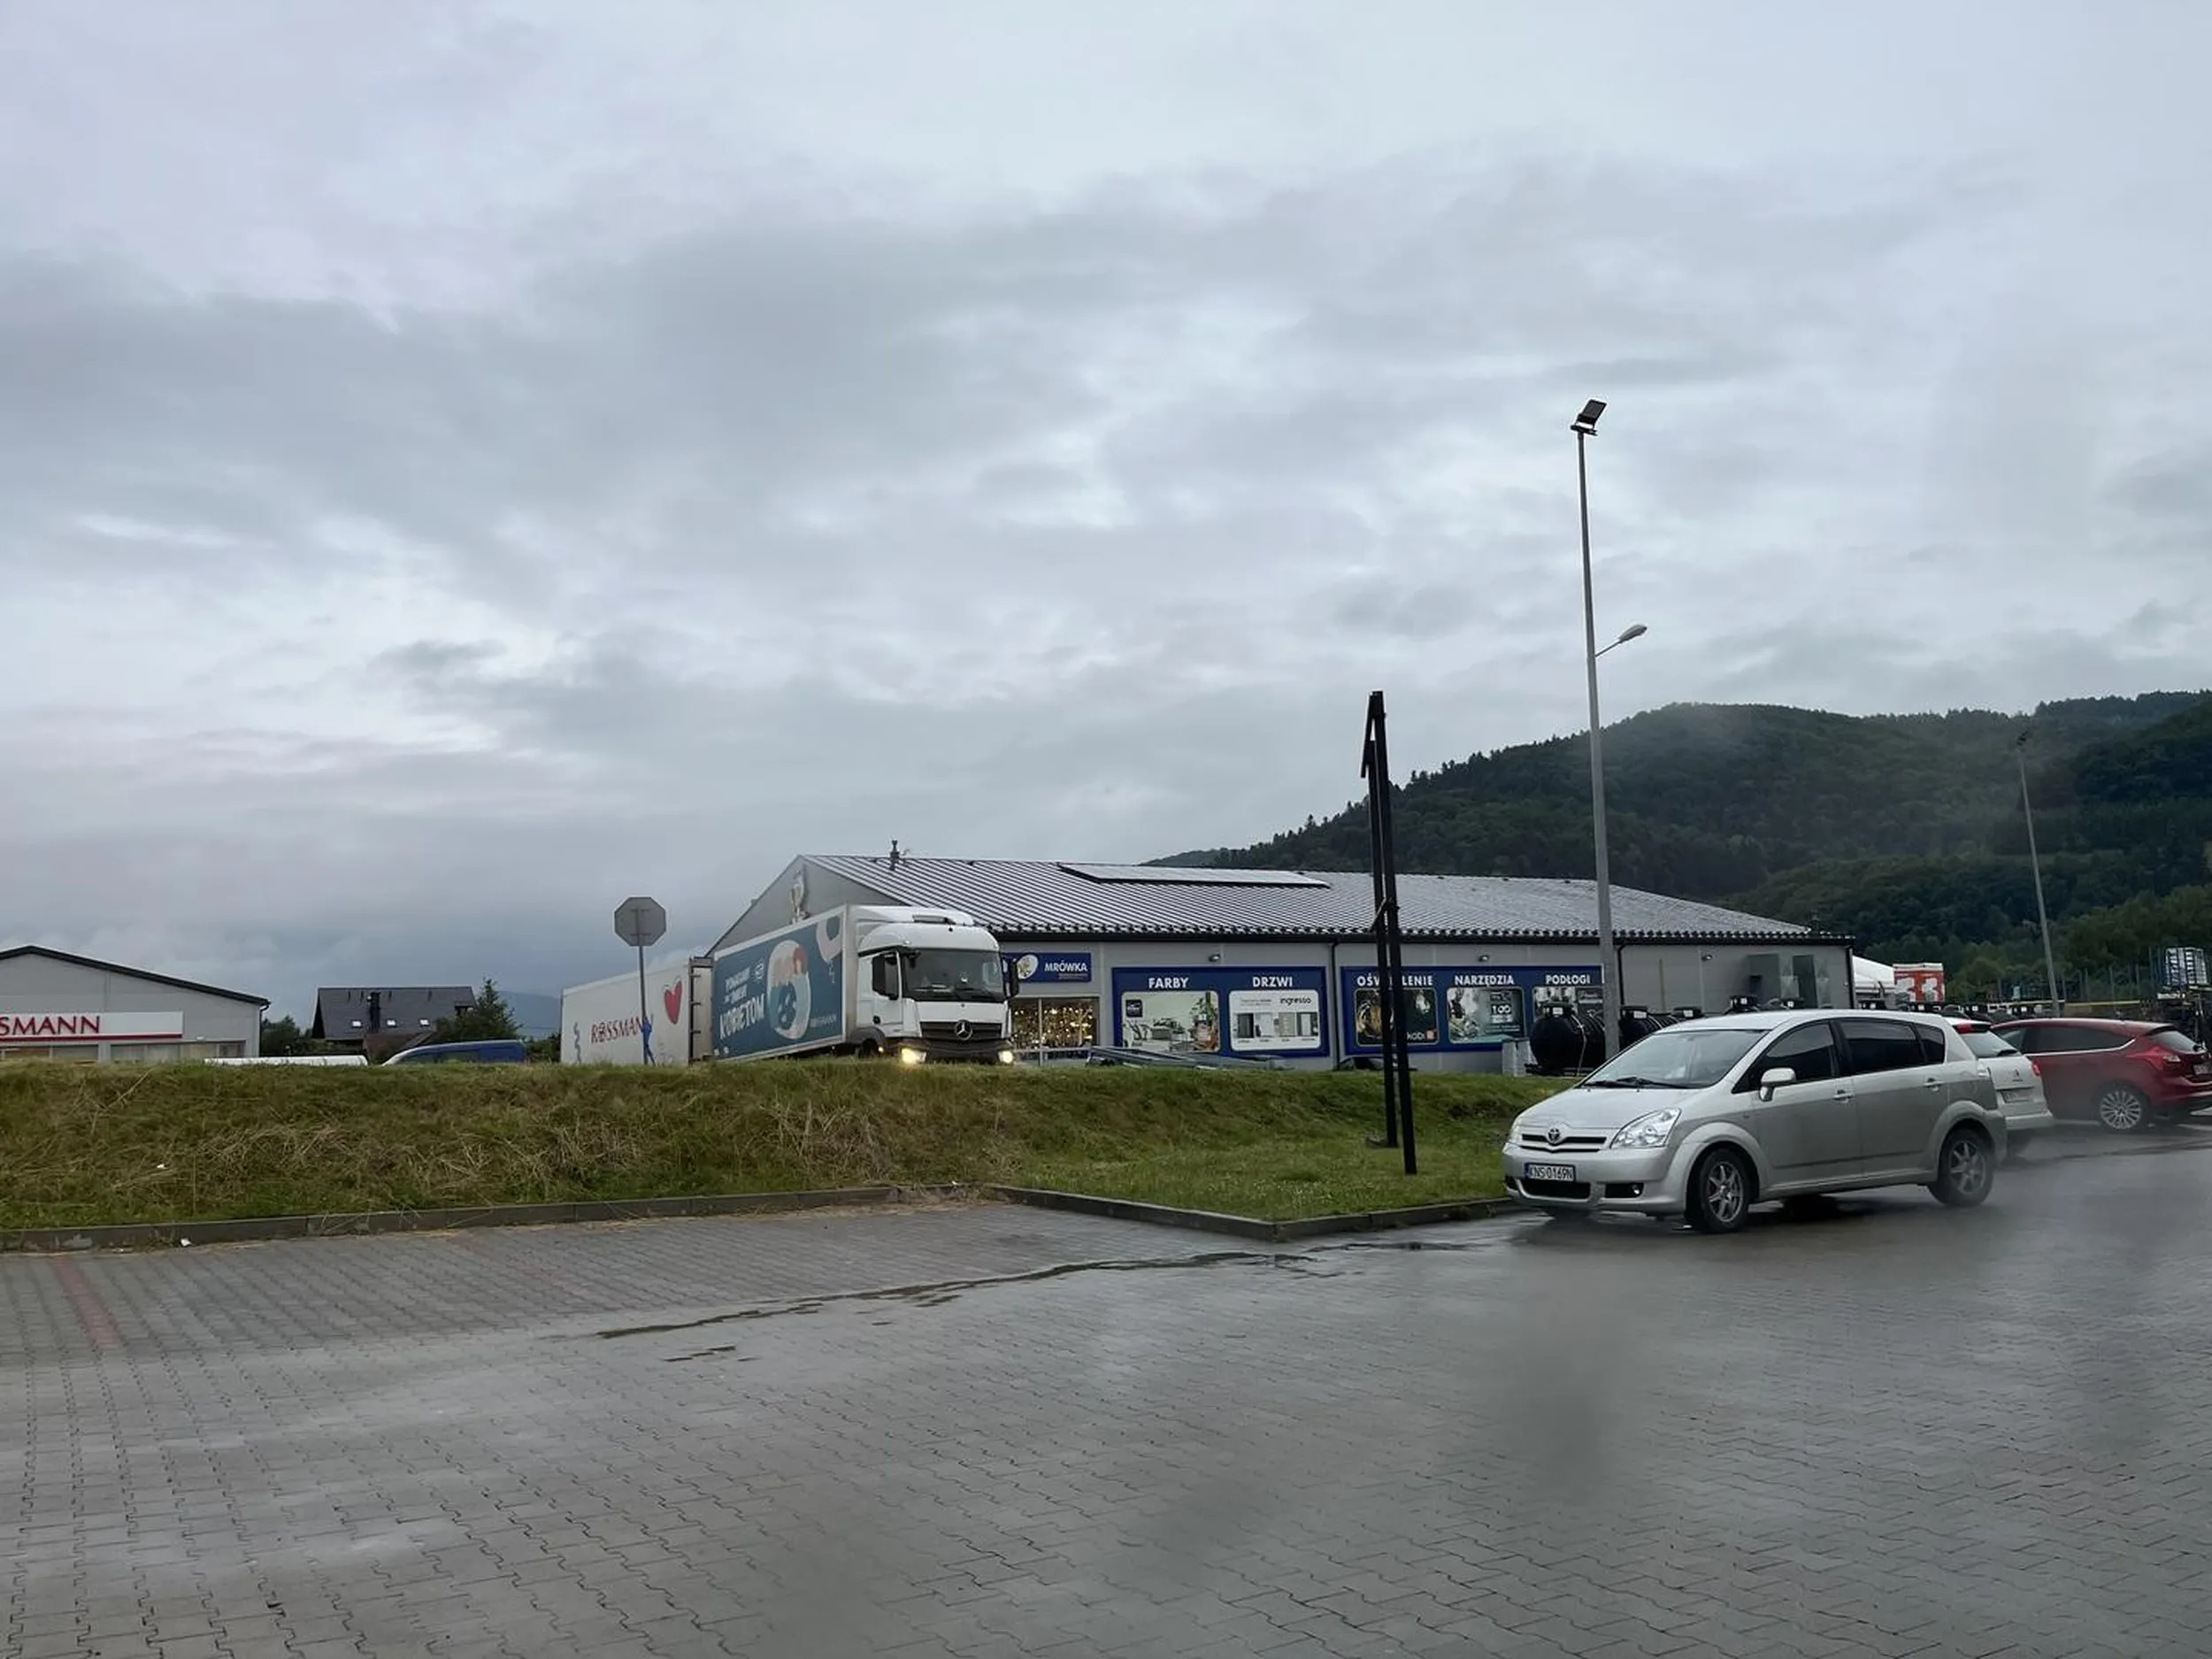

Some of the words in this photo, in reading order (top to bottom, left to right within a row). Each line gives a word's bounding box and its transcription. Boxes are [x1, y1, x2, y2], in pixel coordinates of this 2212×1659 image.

[1044, 960, 1087, 972] MRÓWKA
[1148, 977, 1189, 988] FARBY
[1252, 976, 1294, 987] DRZWI
[1454, 974, 1515, 987] NARZĘDZIA
[1545, 974, 1591, 985] PODŁOGI
